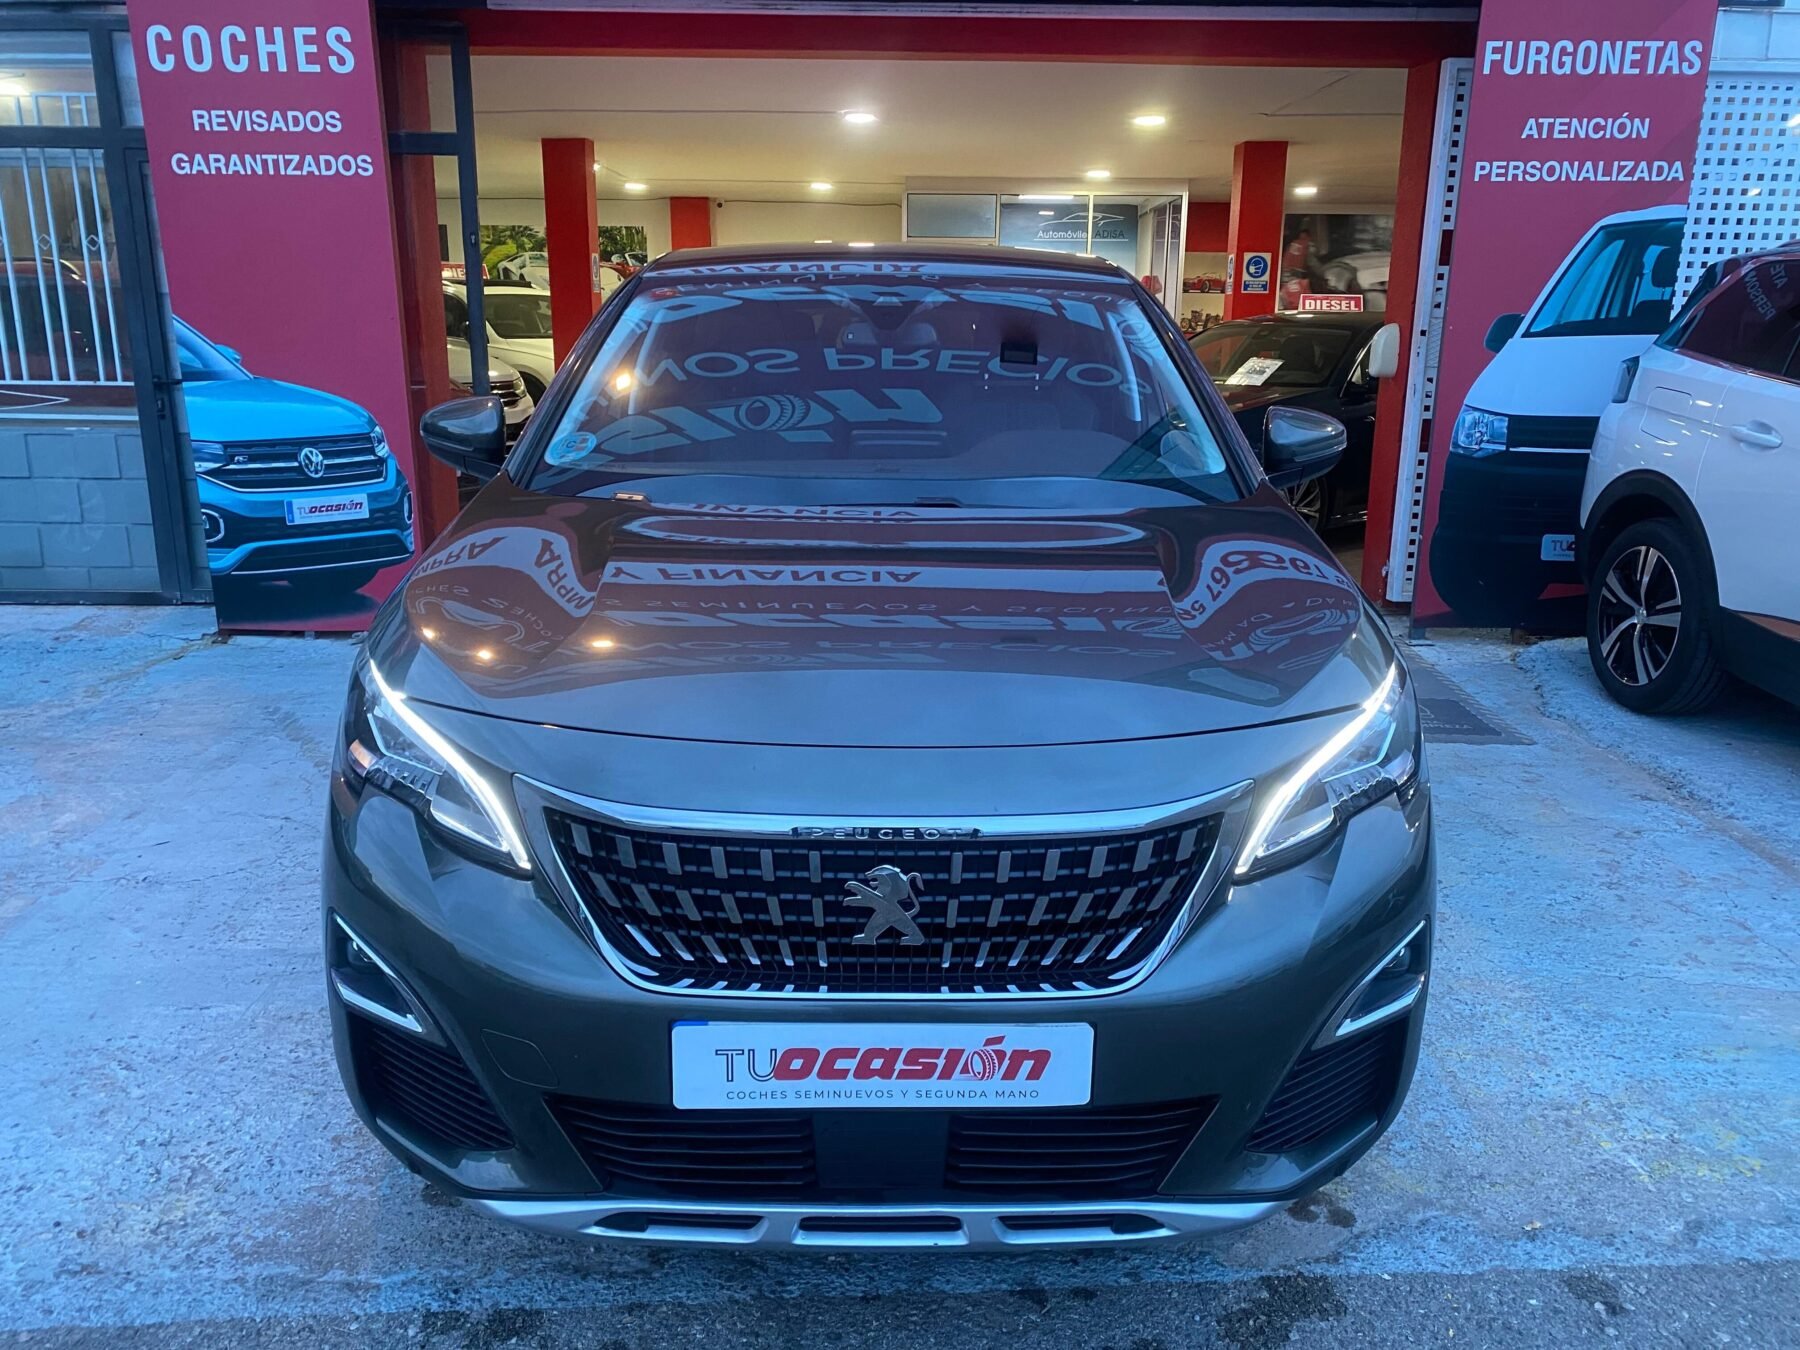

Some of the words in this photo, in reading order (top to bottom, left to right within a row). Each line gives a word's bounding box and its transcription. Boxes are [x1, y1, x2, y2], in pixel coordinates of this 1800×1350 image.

[146, 24, 355, 73] COCHES
[1483, 40, 1703, 75] FURGONETAS
[192, 110, 342, 132] REVISADOS
[1521, 112, 1650, 139] ATENCIÓN
[171, 153, 373, 176] GARANTIZADOS
[1474, 161, 1684, 182] PERSONALIZADA
[1037, 230, 1088, 239] Automóvile
[1095, 229, 1125, 239] ADISA
[1305, 300, 1359, 310] DIESEL
[811, 828, 962, 839] PEUGEOT
[726, 1090, 788, 1100] COCHES
[794, 1089, 894, 1100] SEMINUEVOS
[900, 1089, 908, 1099] Y
[915, 1089, 988, 1099] SEGUNDA
[995, 1089, 1040, 1099] MANO
